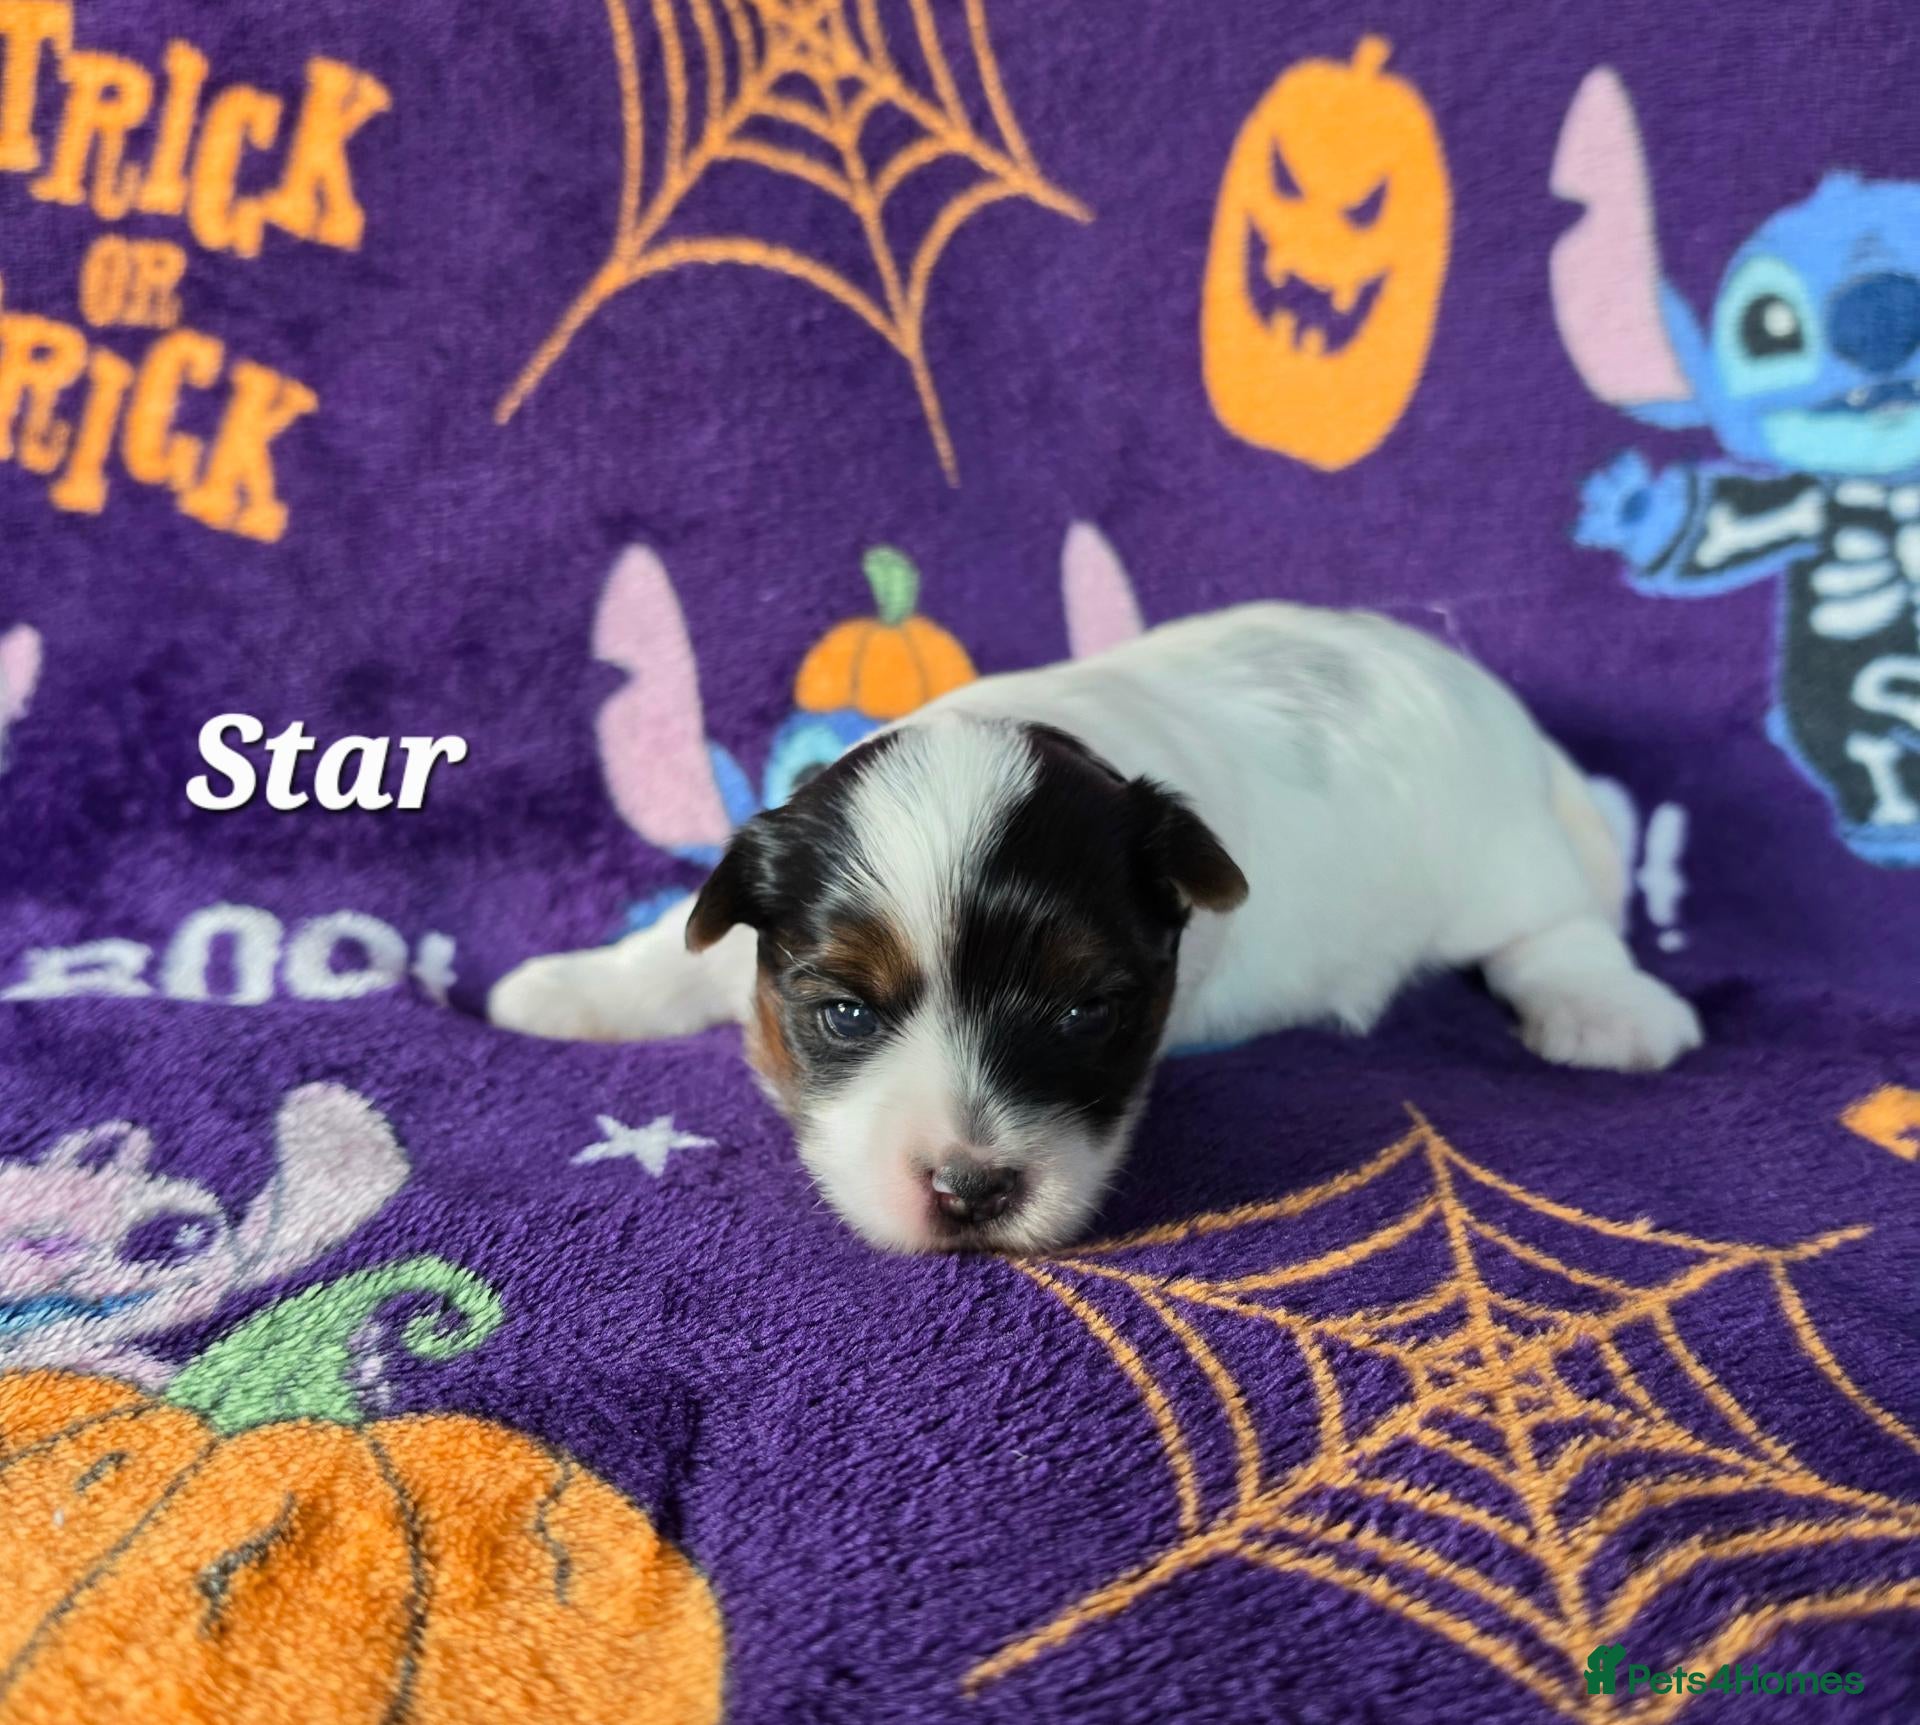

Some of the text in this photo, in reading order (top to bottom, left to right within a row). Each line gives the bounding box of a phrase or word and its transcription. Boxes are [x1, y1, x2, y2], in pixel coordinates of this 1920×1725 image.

[0, 0, 392, 258] TRICK
[80, 235, 187, 328] OR
[0, 313, 318, 542] RICK
